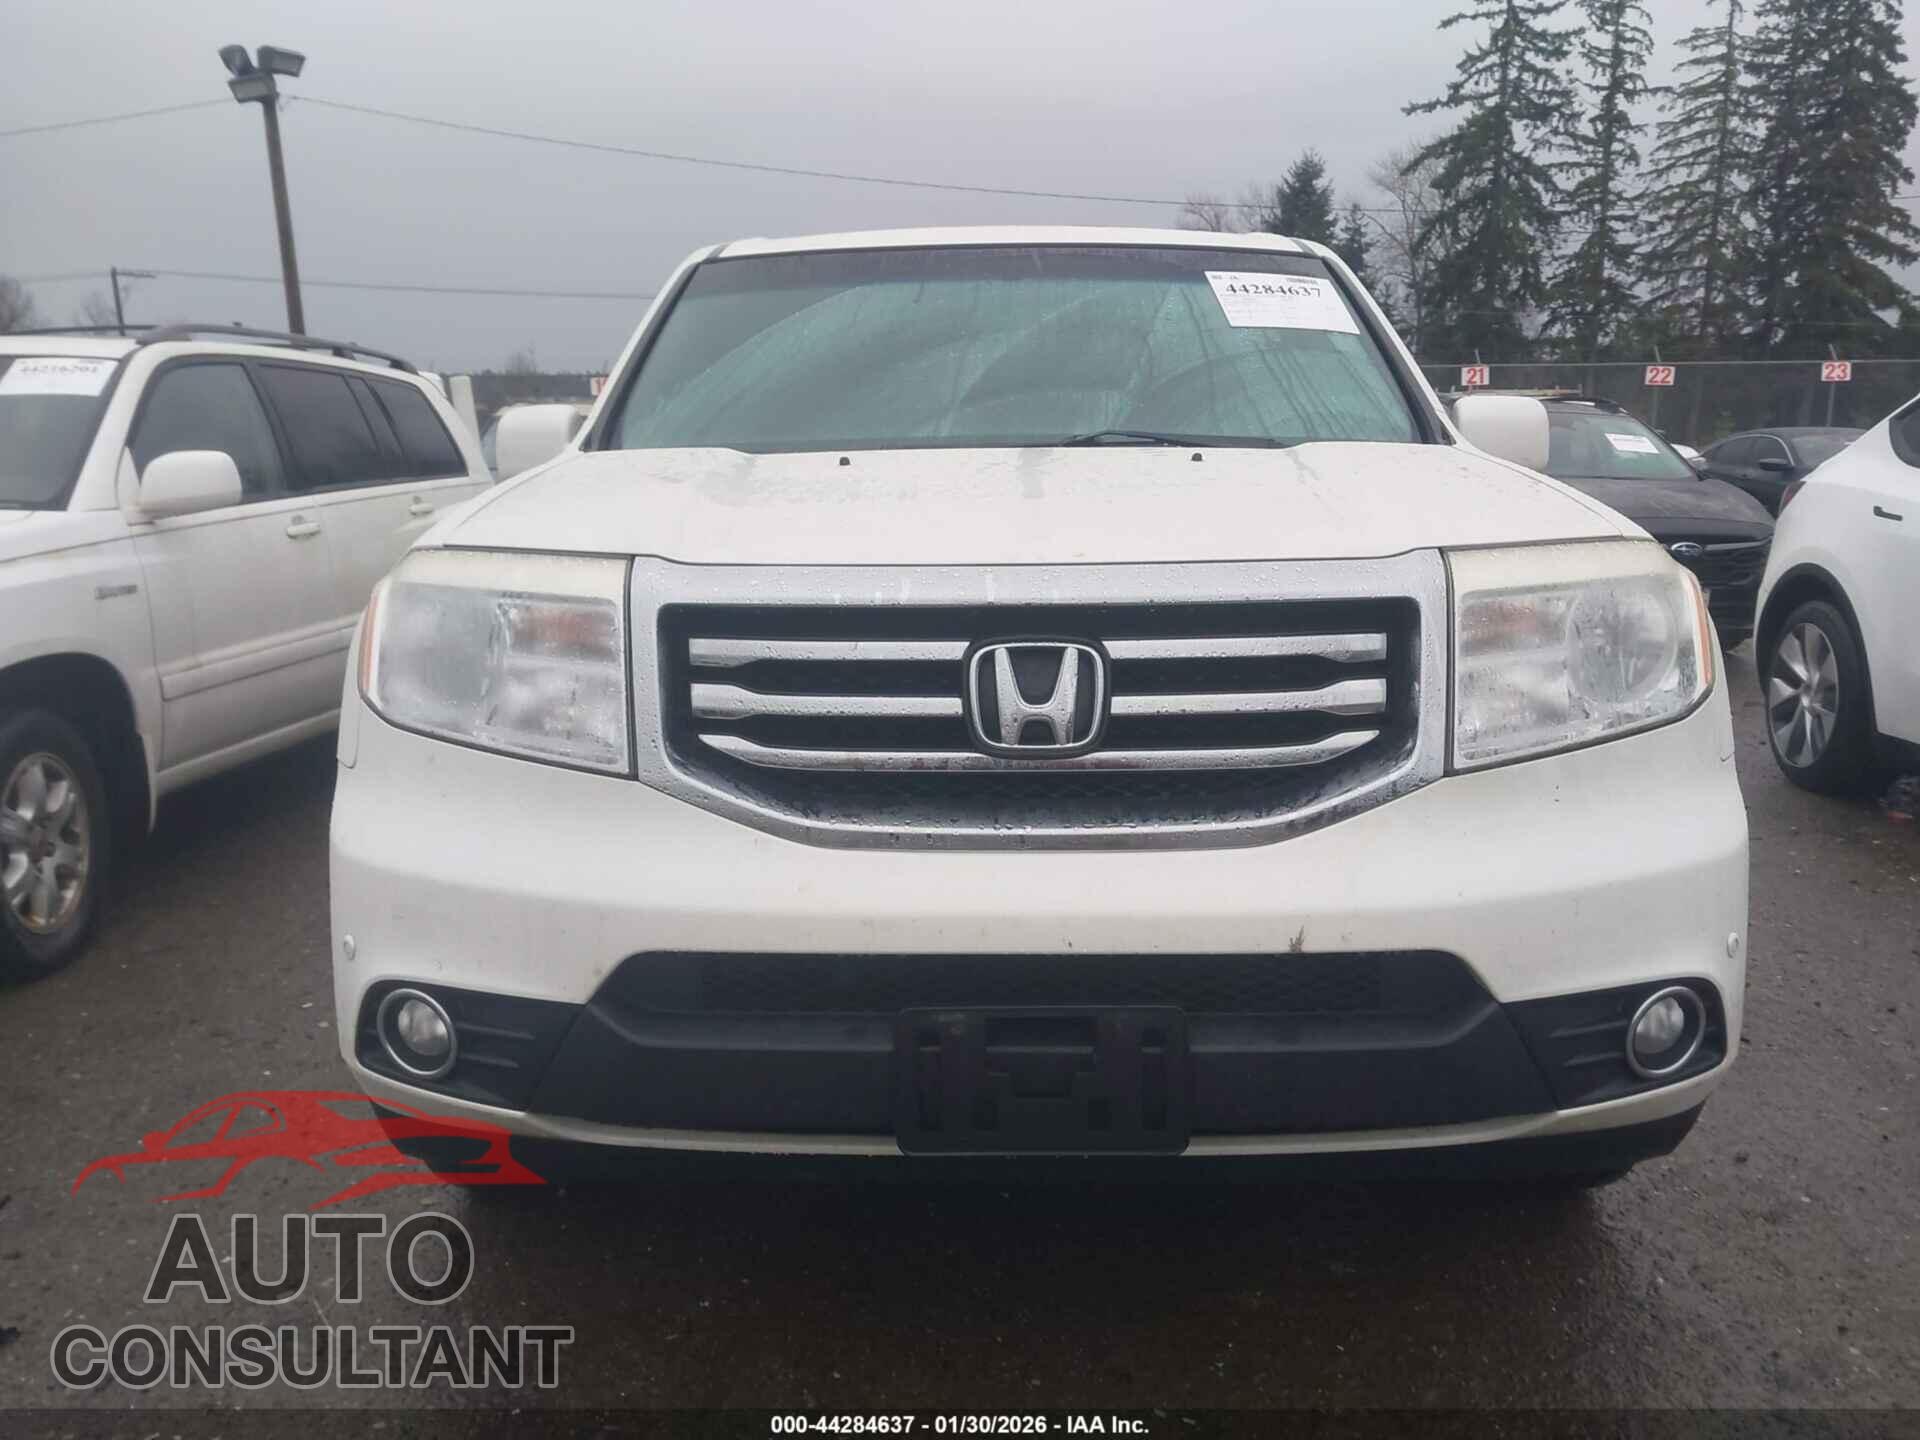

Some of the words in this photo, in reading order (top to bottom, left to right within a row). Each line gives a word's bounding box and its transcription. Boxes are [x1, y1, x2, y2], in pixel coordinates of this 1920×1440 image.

[1226, 283, 1321, 298] 44284637
[1466, 367, 1485, 385] 21
[1648, 367, 1672, 384] 22
[1824, 363, 1848, 380] 23
